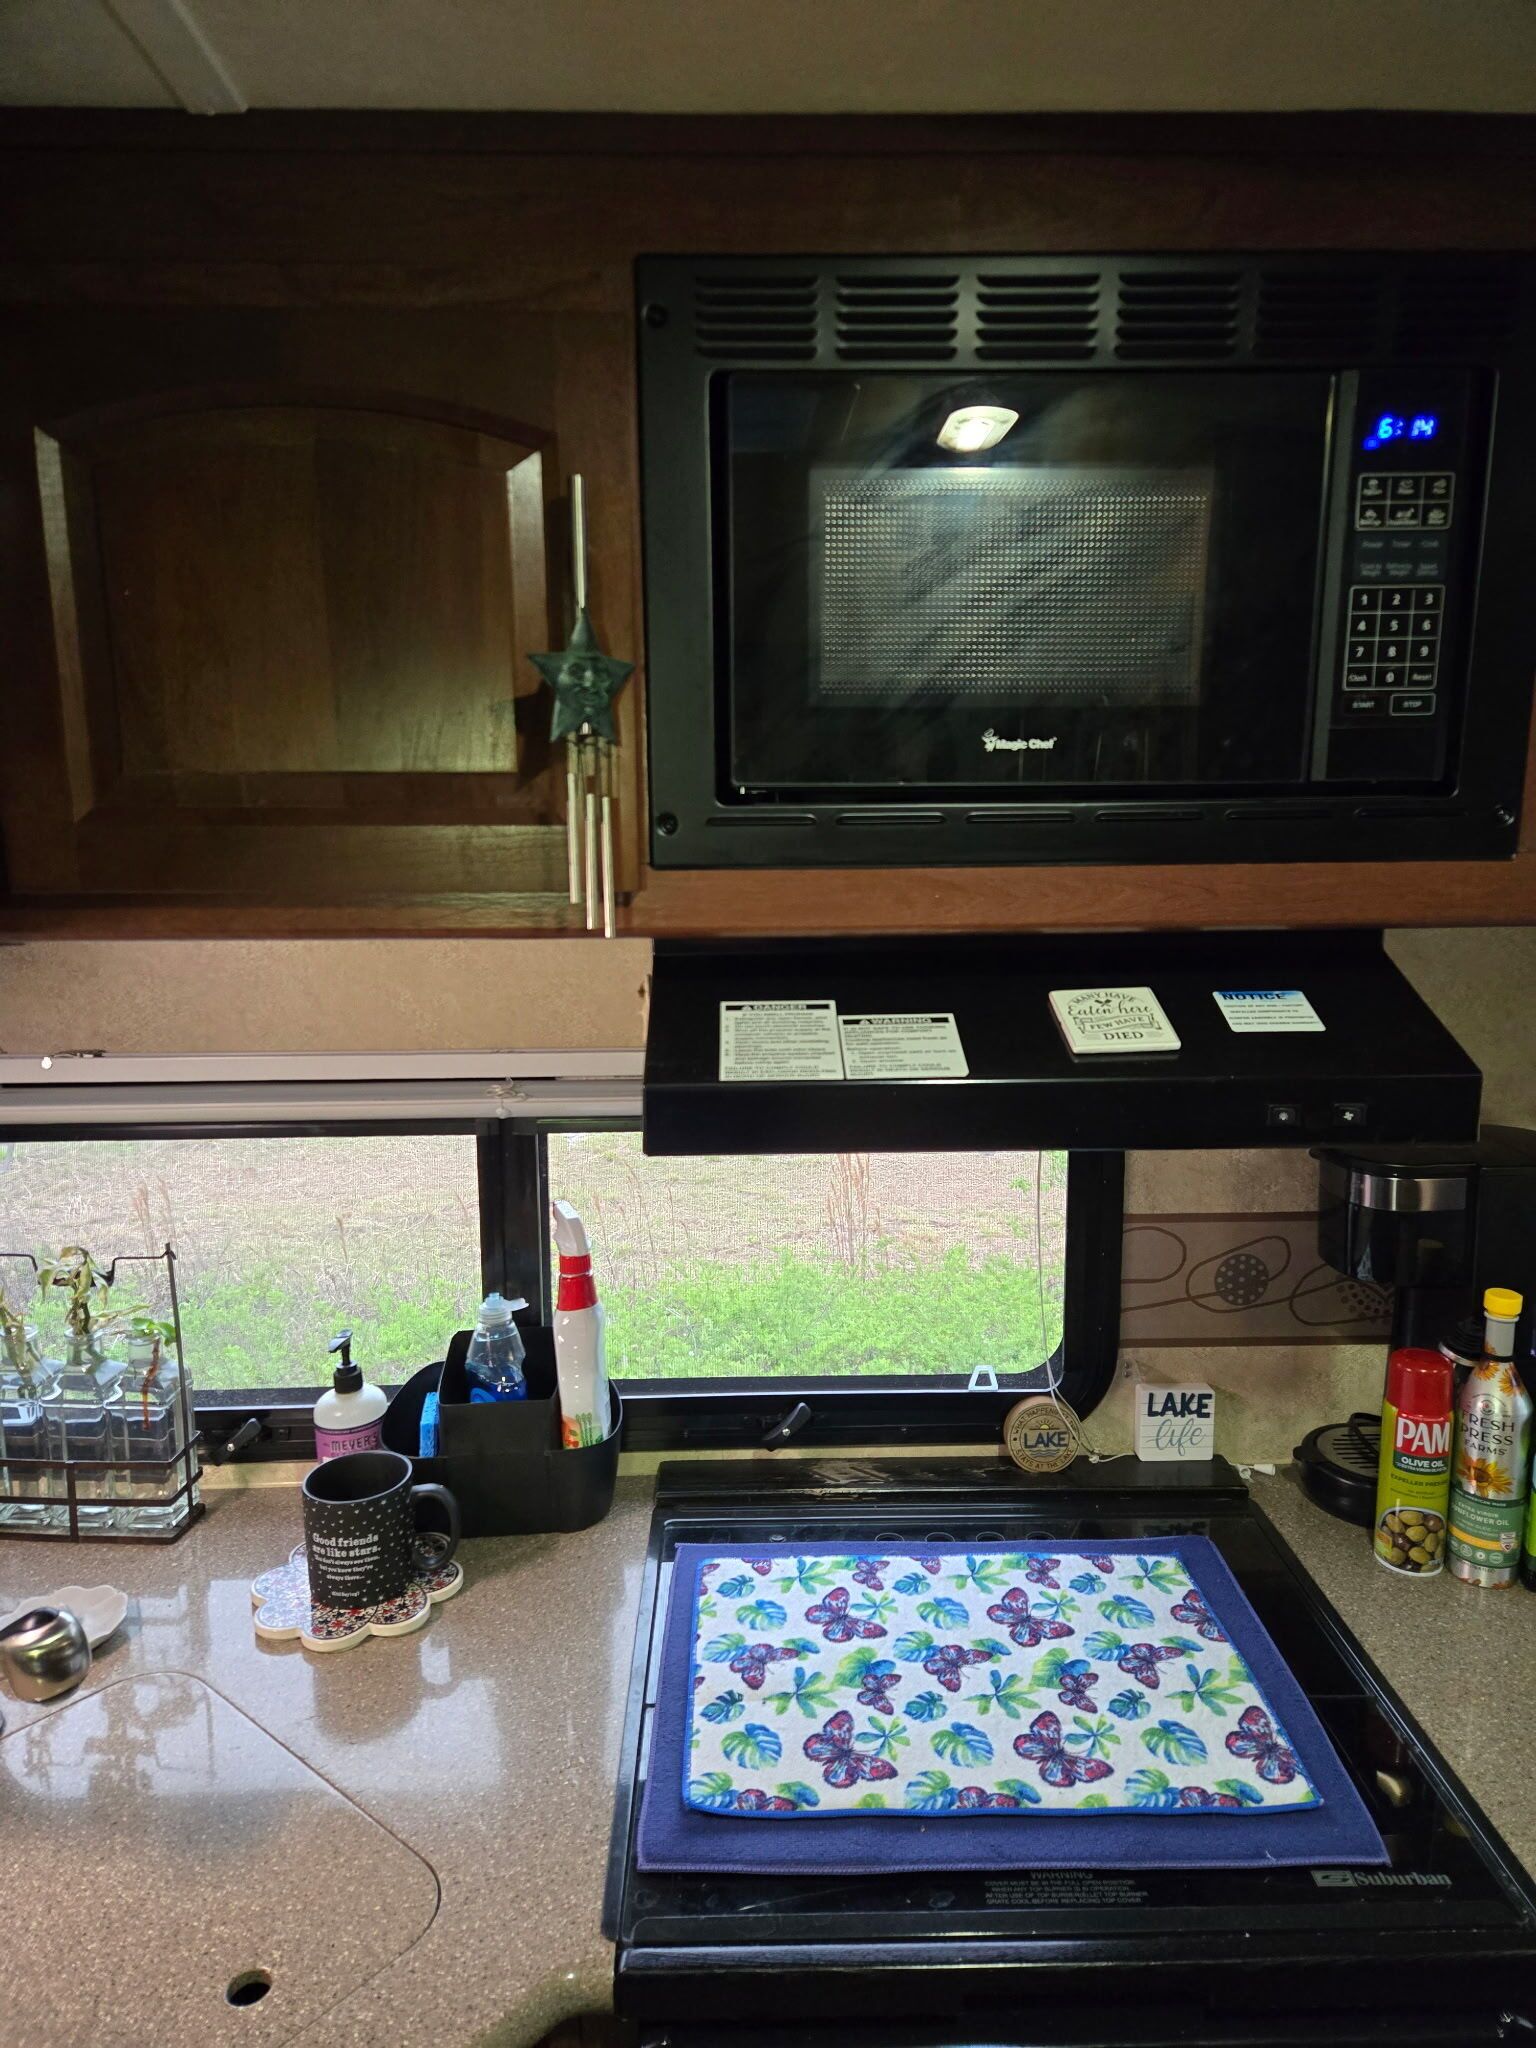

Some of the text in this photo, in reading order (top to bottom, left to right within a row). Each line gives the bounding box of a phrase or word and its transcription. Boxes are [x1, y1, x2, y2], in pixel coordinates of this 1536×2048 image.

[1376, 415, 1436, 440] 6:14
[1361, 593, 1369, 606] 1
[1392, 593, 1401, 606] 2
[1424, 592, 1434, 606] 3
[1356, 620, 1367, 632] 4
[1388, 619, 1399, 632] 5
[1421, 619, 1432, 632] 6
[1354, 645, 1365, 658] 7
[1386, 645, 1397, 658] 8
[1419, 645, 1429, 657] 9
[1385, 671, 1395, 683] 0
[1028, 738, 1055, 750] Chef
[1072, 991, 1136, 1004] MANY HAVE
[1220, 992, 1288, 1001] NOTICE
[753, 1003, 807, 1011] DANGER
[1067, 1000, 1153, 1017] Eaten here
[873, 1017, 932, 1025] WARNING
[1089, 1016, 1146, 1031] FEW HAVE
[1103, 1032, 1145, 1041] DIED
[1147, 1392, 1213, 1418] LAKE
[1462, 1409, 1515, 1433] FRESH
[1023, 1431, 1069, 1449] LAKE
[1145, 1418, 1207, 1457] life
[1396, 1416, 1451, 1455] PAM
[1460, 1422, 1515, 1446] PRESS
[1464, 1438, 1508, 1456] FARMS
[1015, 1449, 1034, 1467] STAYS
[1401, 1456, 1430, 1468] OLIVE
[1430, 1460, 1445, 1468] OIL
[313, 1533, 379, 1547] Good friends
[312, 1545, 381, 1558] are like stars.
[1030, 1871, 1094, 1880] WARNING
[1354, 1871, 1453, 1887] Suburban
